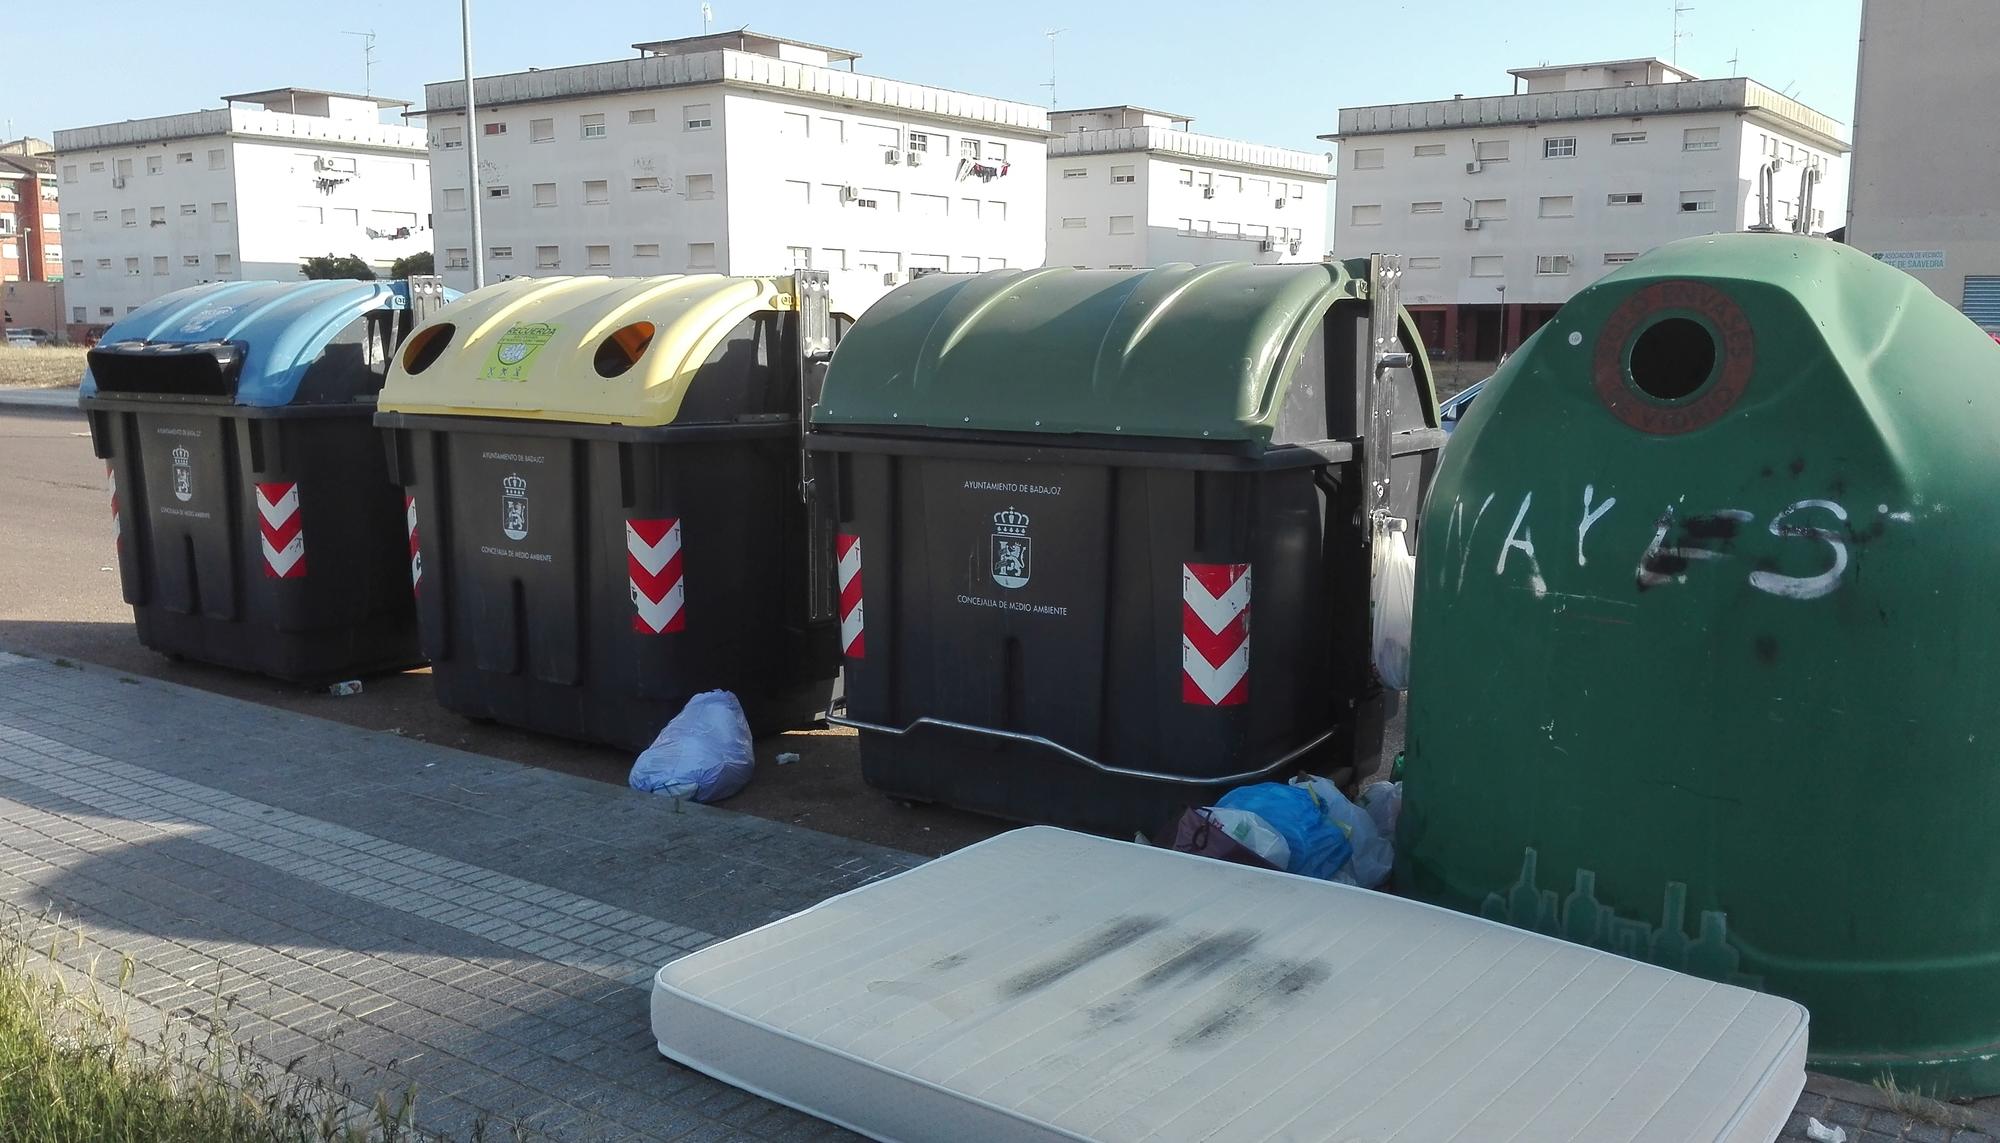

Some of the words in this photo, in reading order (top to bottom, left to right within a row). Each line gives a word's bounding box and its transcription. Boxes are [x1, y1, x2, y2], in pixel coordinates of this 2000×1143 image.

[1908, 260, 1944, 268] SAAVEDRA
[1662, 283, 1752, 358] ENVASES
[507, 327, 557, 336] RECUERDA
[964, 480, 1018, 492] AYUNTAMIENTO
[1019, 484, 1028, 493] DE
[1029, 485, 1062, 495] BADAJOZ
[514, 552, 530, 560] MEDIO
[530, 553, 552, 562] AMBIENTE
[957, 595, 998, 607] CONCEJALIA
[998, 600, 1008, 609] DE
[1009, 602, 1031, 612] MEDIO
[1033, 605, 1067, 616] AMBIENTE
